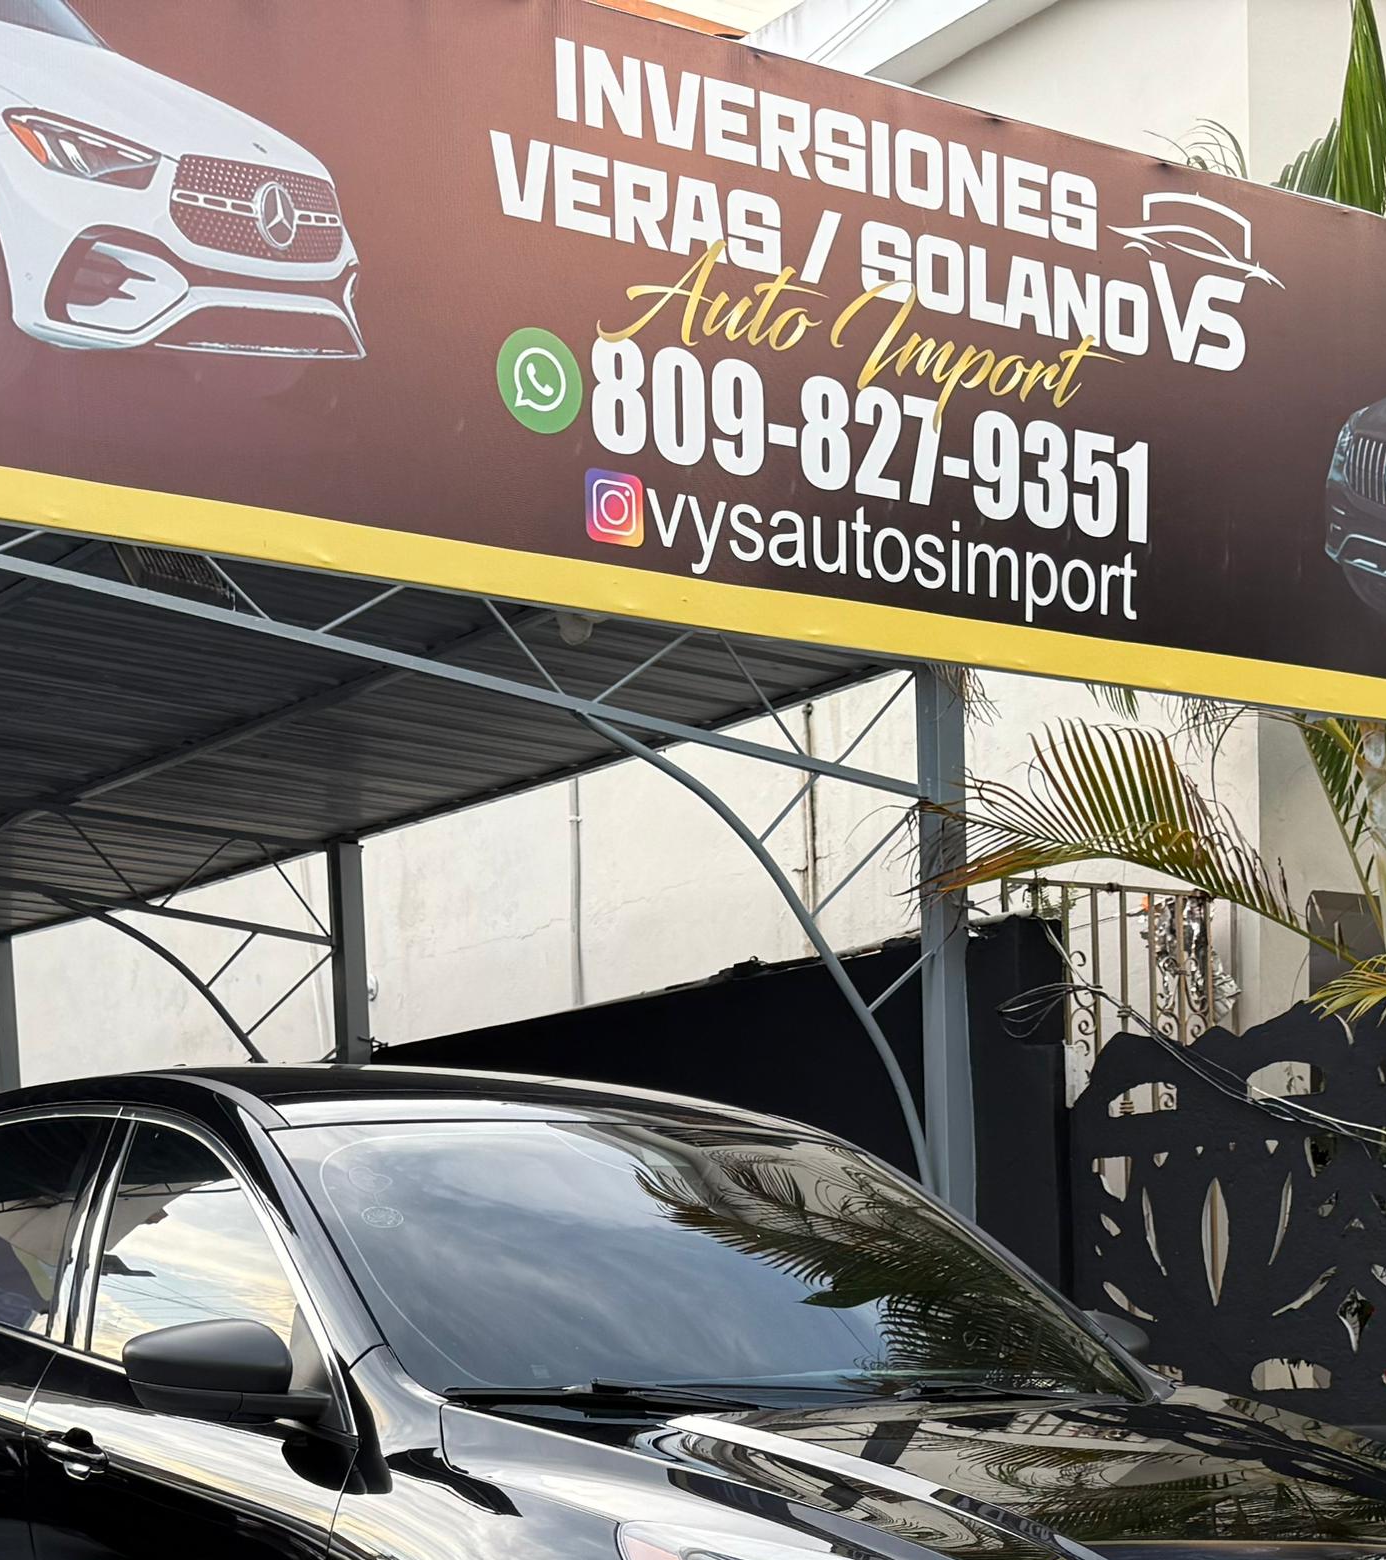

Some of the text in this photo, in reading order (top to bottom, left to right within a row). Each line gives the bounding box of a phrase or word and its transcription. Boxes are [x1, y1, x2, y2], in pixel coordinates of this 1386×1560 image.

[489, 129, 1149, 357] VERAS / SOLANO
[554, 36, 1098, 251] INVERSIONES
[595, 239, 1126, 436] Auto Import
[1148, 260, 1247, 373] VS
[589, 336, 1149, 546] 809-827-9351
[644, 485, 1139, 623] vysautosimport
